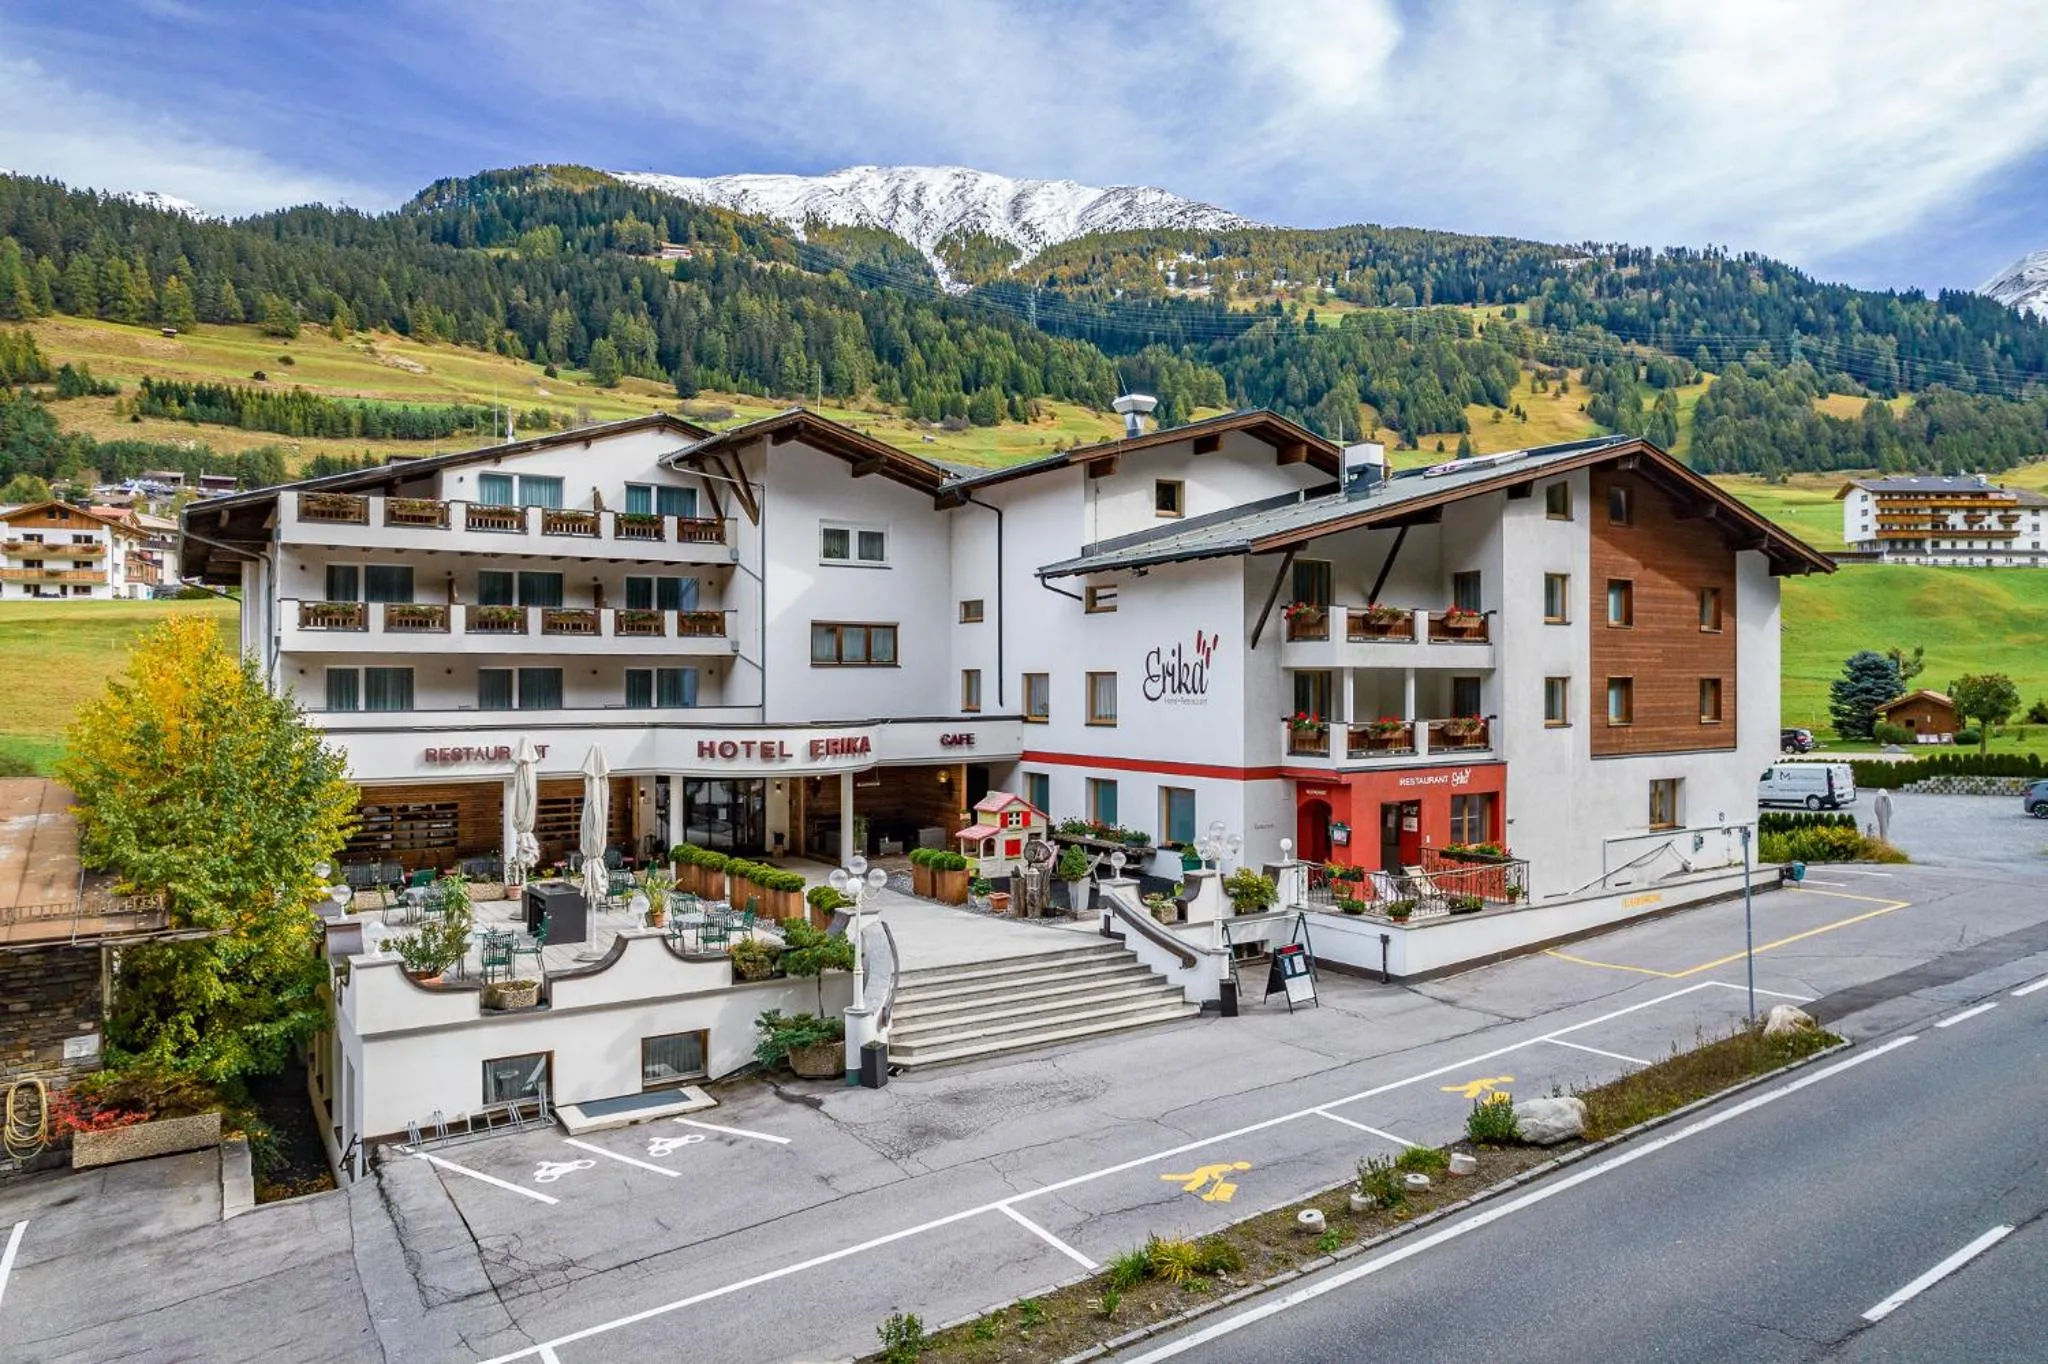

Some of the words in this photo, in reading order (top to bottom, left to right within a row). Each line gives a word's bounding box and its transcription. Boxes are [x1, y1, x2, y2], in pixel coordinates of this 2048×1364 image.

[1143, 642, 1209, 702] Erika
[697, 740, 794, 760] HOTEL
[809, 735, 873, 758] ERIKA
[940, 732, 976, 748] CAFE
[425, 744, 551, 763] RESTAURT
[1399, 775, 1449, 786] RESTAURANT
